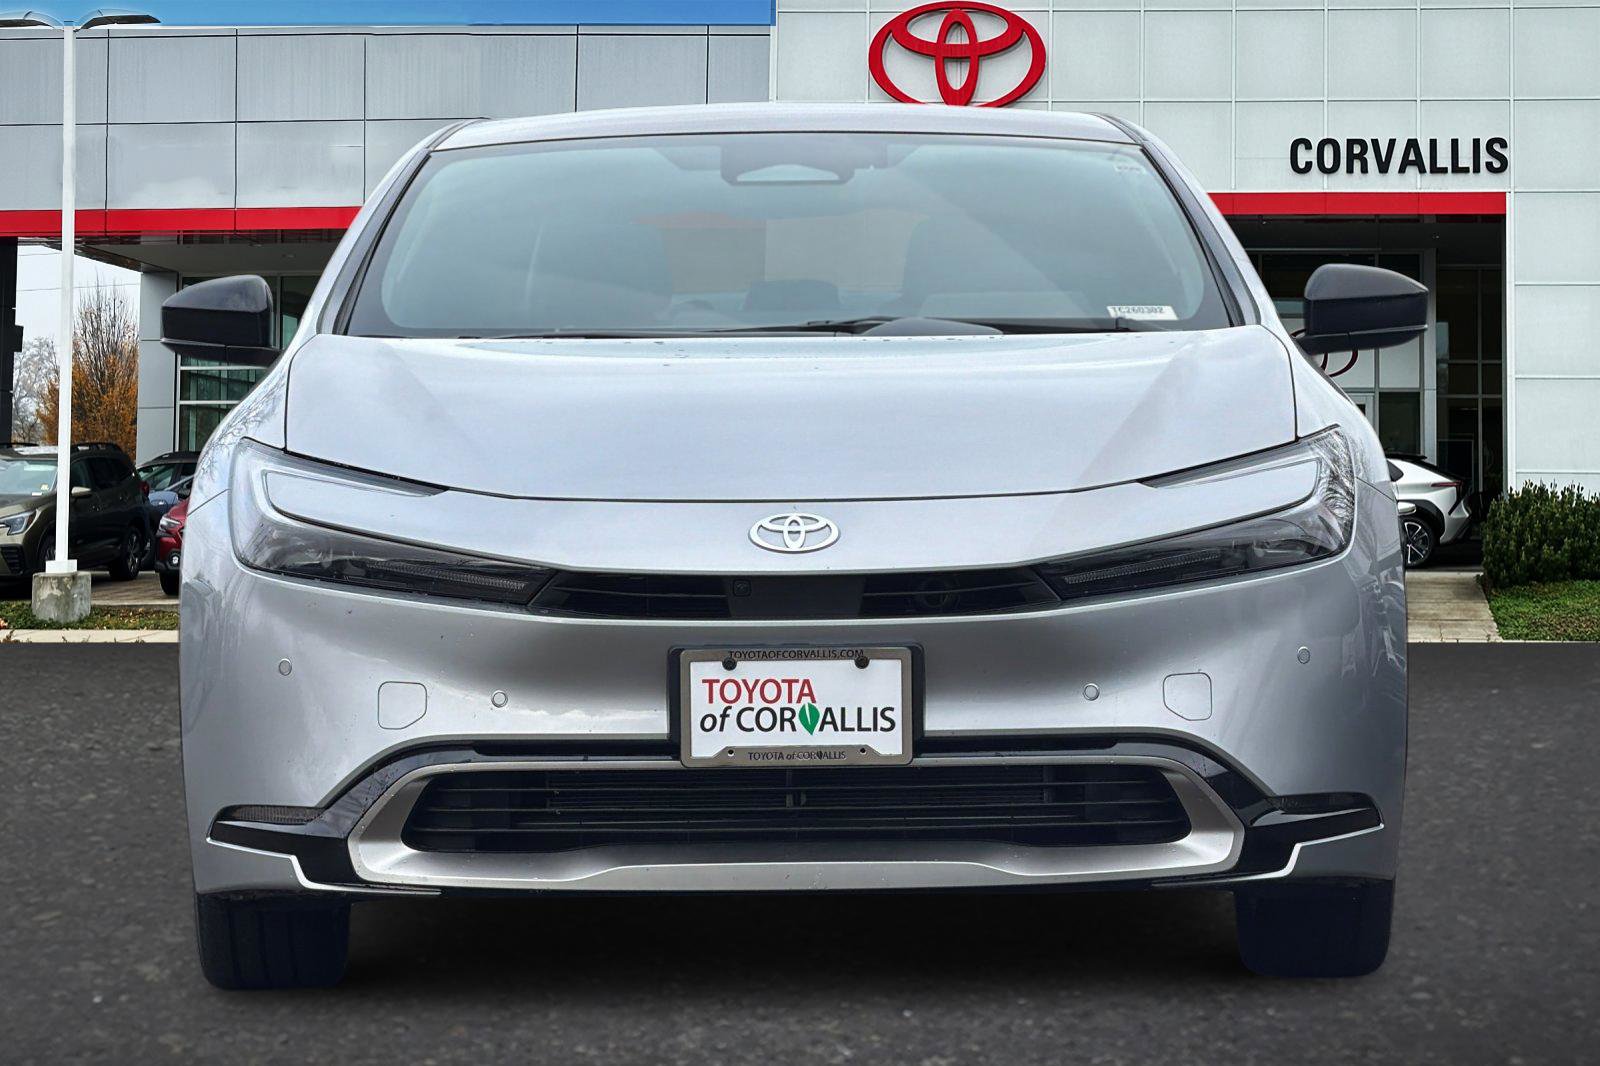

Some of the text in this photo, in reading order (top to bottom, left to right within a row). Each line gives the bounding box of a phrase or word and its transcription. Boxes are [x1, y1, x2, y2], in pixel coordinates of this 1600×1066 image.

[1290, 138, 1508, 174] CORVALLIS
[729, 649, 864, 659] TOYOTAOFCORVALLIS.COM
[702, 679, 816, 704] TOYOTA
[700, 706, 732, 732] of
[748, 752, 784, 760] TOYOTA
